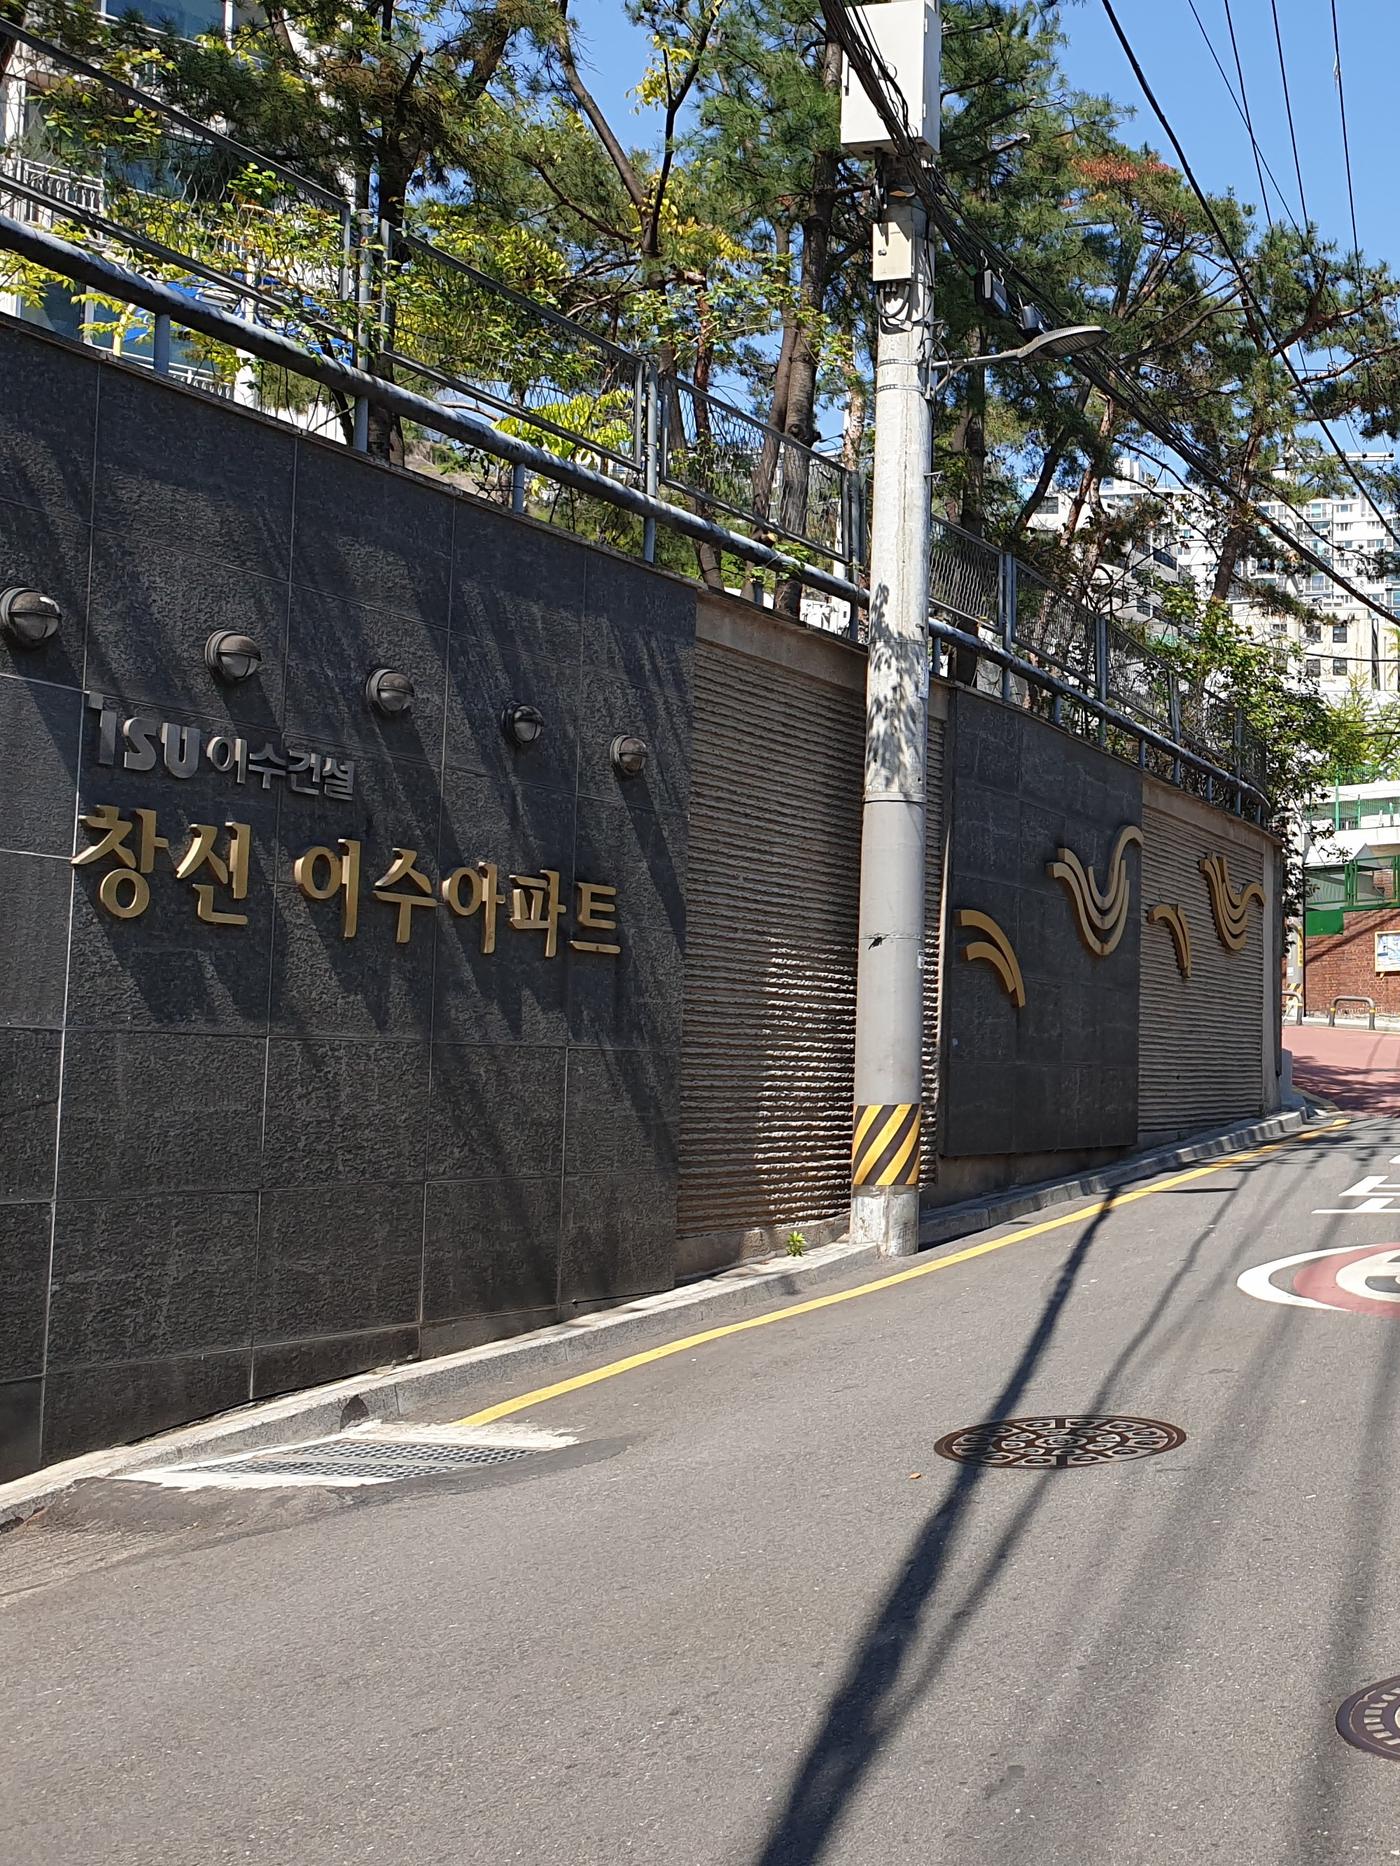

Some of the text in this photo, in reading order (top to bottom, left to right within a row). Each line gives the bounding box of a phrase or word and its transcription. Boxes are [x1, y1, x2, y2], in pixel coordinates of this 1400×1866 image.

[206, 734, 356, 801] 이수건설
[71, 804, 621, 958] 창신 이수아파트
